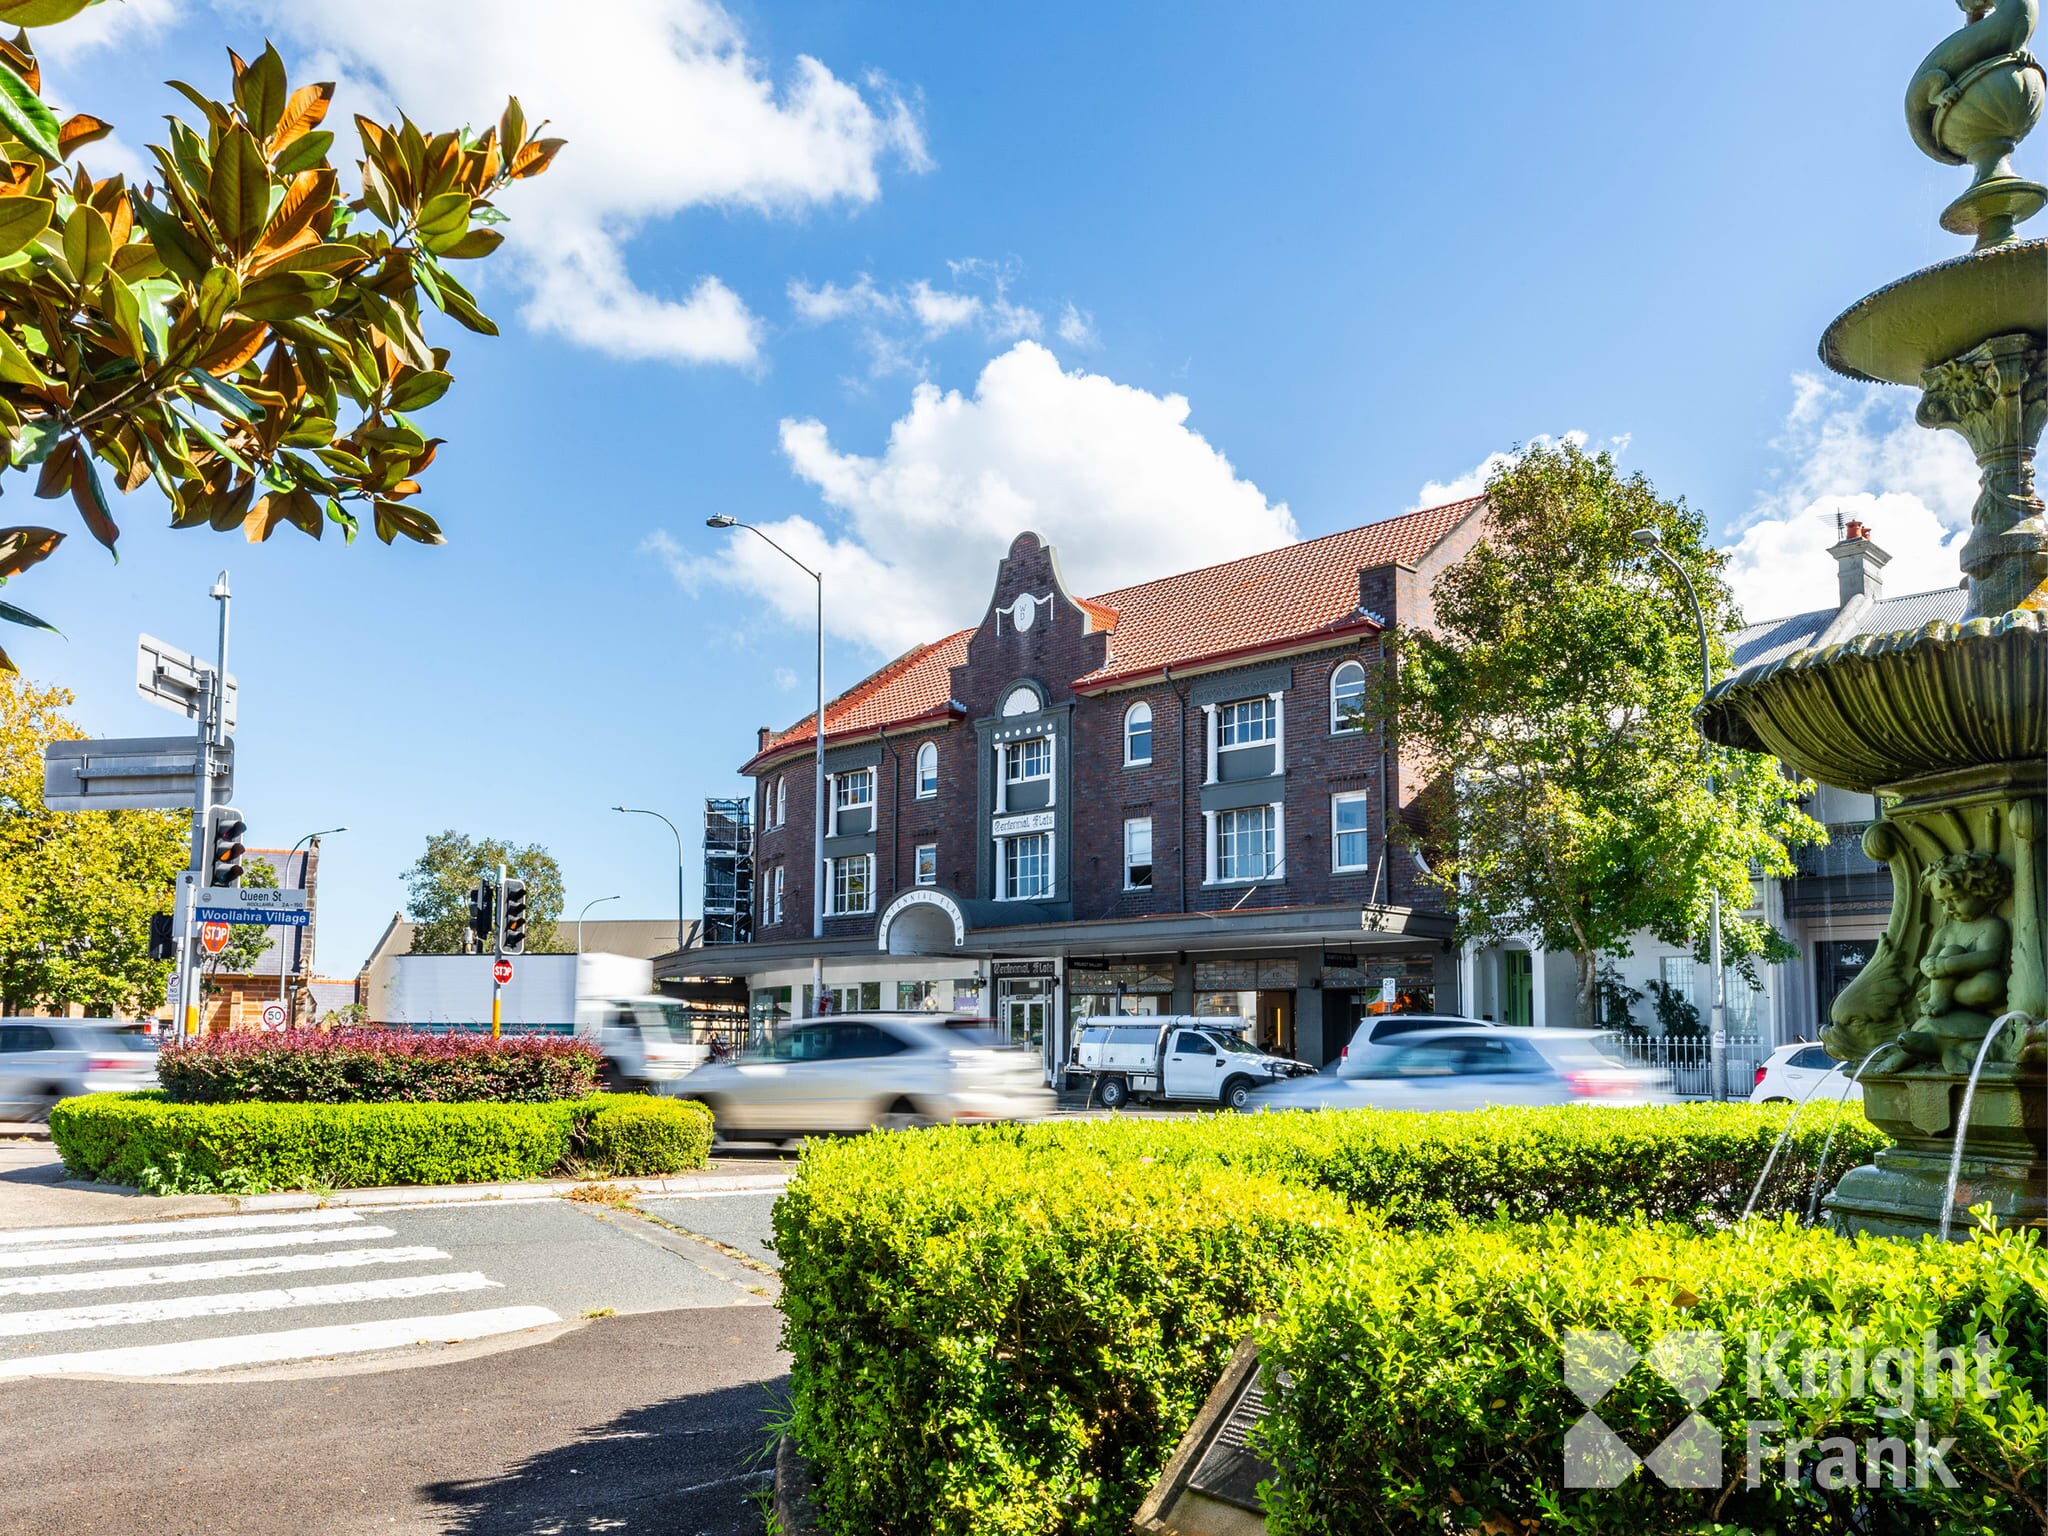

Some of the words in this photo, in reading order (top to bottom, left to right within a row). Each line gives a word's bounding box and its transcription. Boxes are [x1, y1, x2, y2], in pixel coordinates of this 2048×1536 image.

[993, 816, 1030, 832] Centennial
[1032, 814, 1053, 829] Flats
[240, 890, 269, 902] Queen
[272, 890, 282, 902] St
[202, 909, 262, 922] Woollahra
[266, 911, 307, 925] Village
[881, 893, 932, 937] CENTENNIAL
[940, 897, 962, 931] FLATS
[205, 925, 227, 941] STOP
[494, 966, 511, 976] STOP
[993, 963, 1030, 974] Centennial
[1032, 961, 1054, 973] Flats
[267, 1011, 282, 1020] 50
